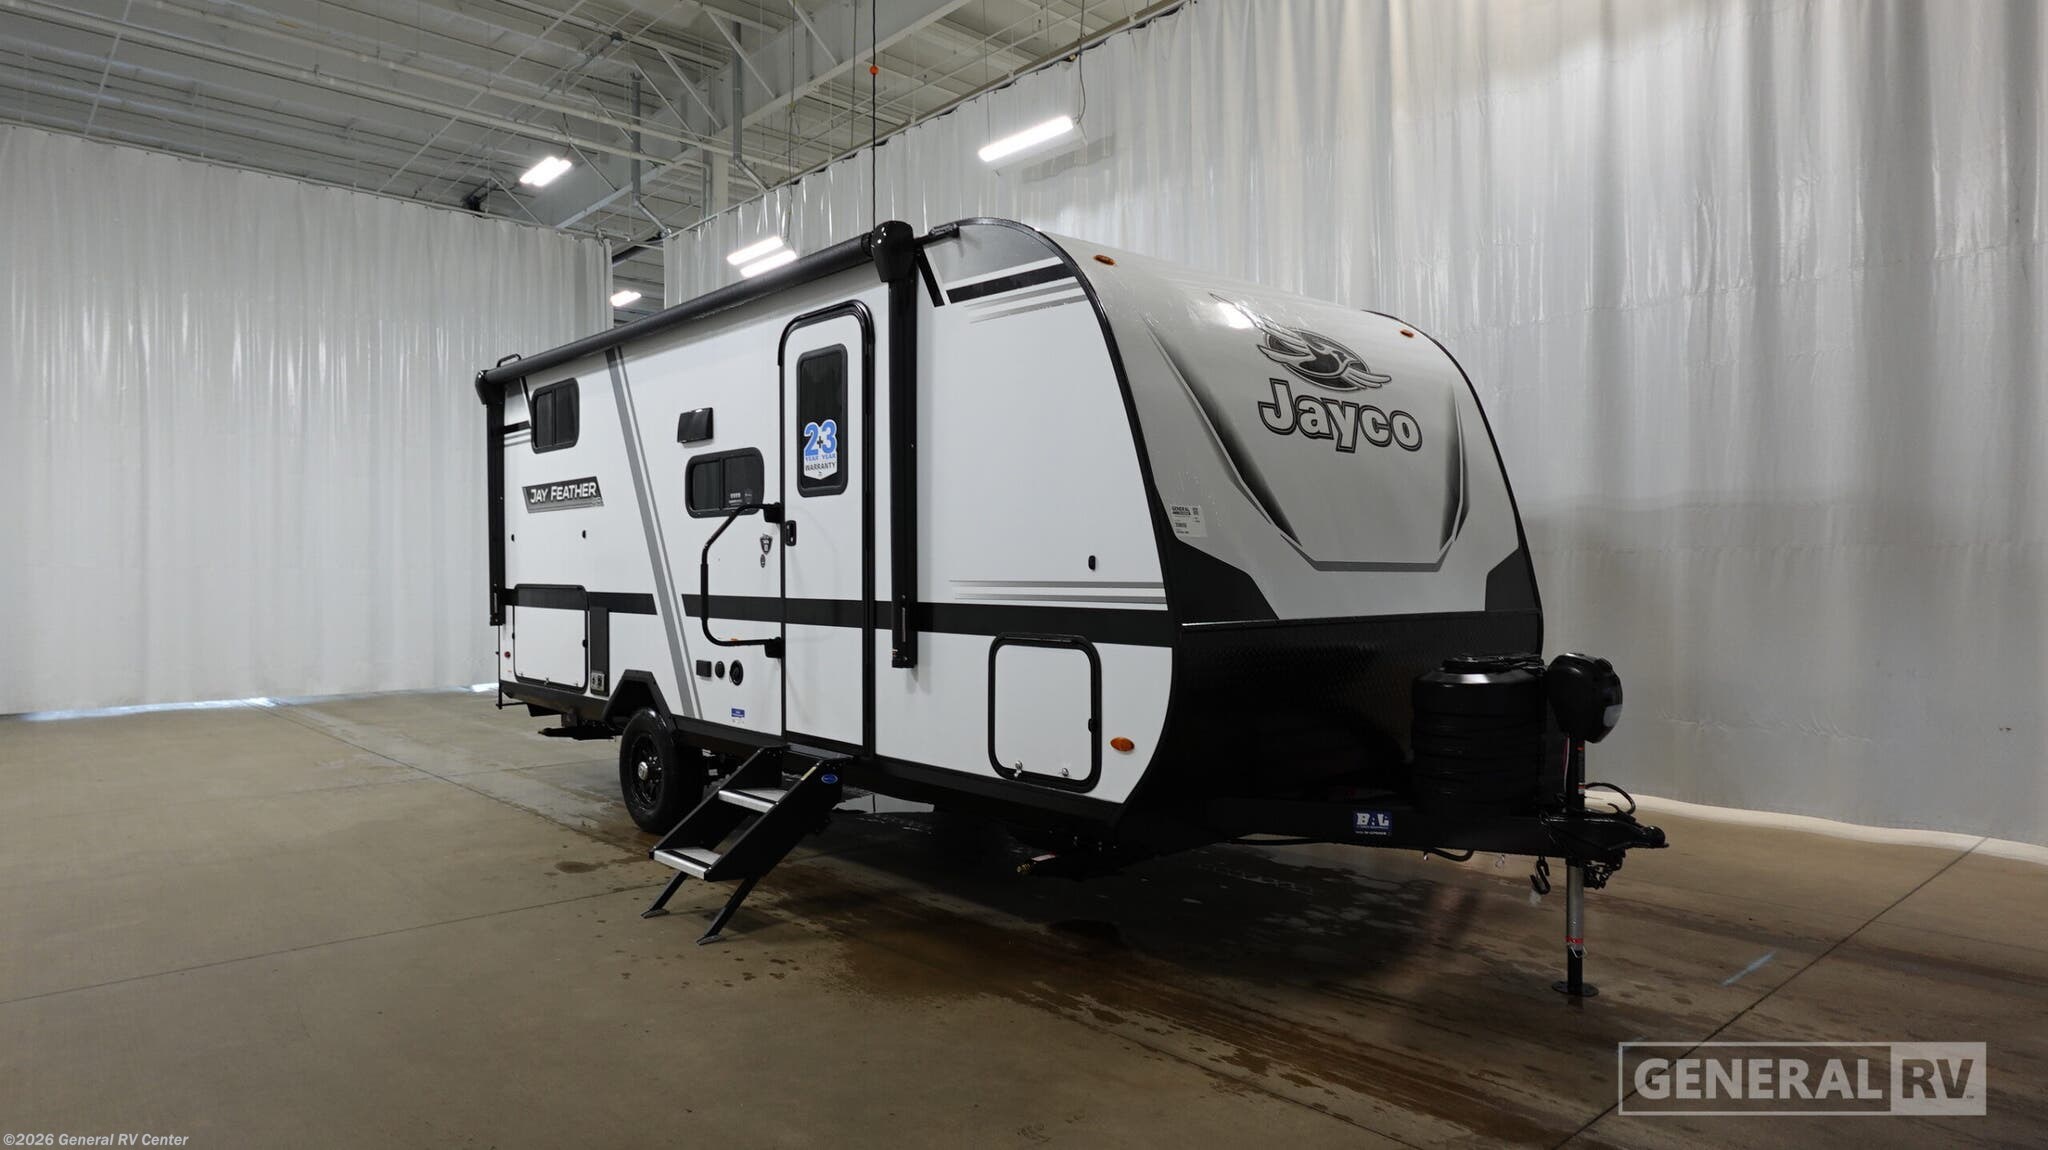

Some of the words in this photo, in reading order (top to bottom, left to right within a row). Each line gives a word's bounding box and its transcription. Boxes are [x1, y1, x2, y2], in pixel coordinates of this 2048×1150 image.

[1258, 377, 1422, 453] Jayco
[805, 462, 836, 471] WARRANTY
[530, 488, 548, 503] JAY
[550, 482, 597, 501] FEATHER
